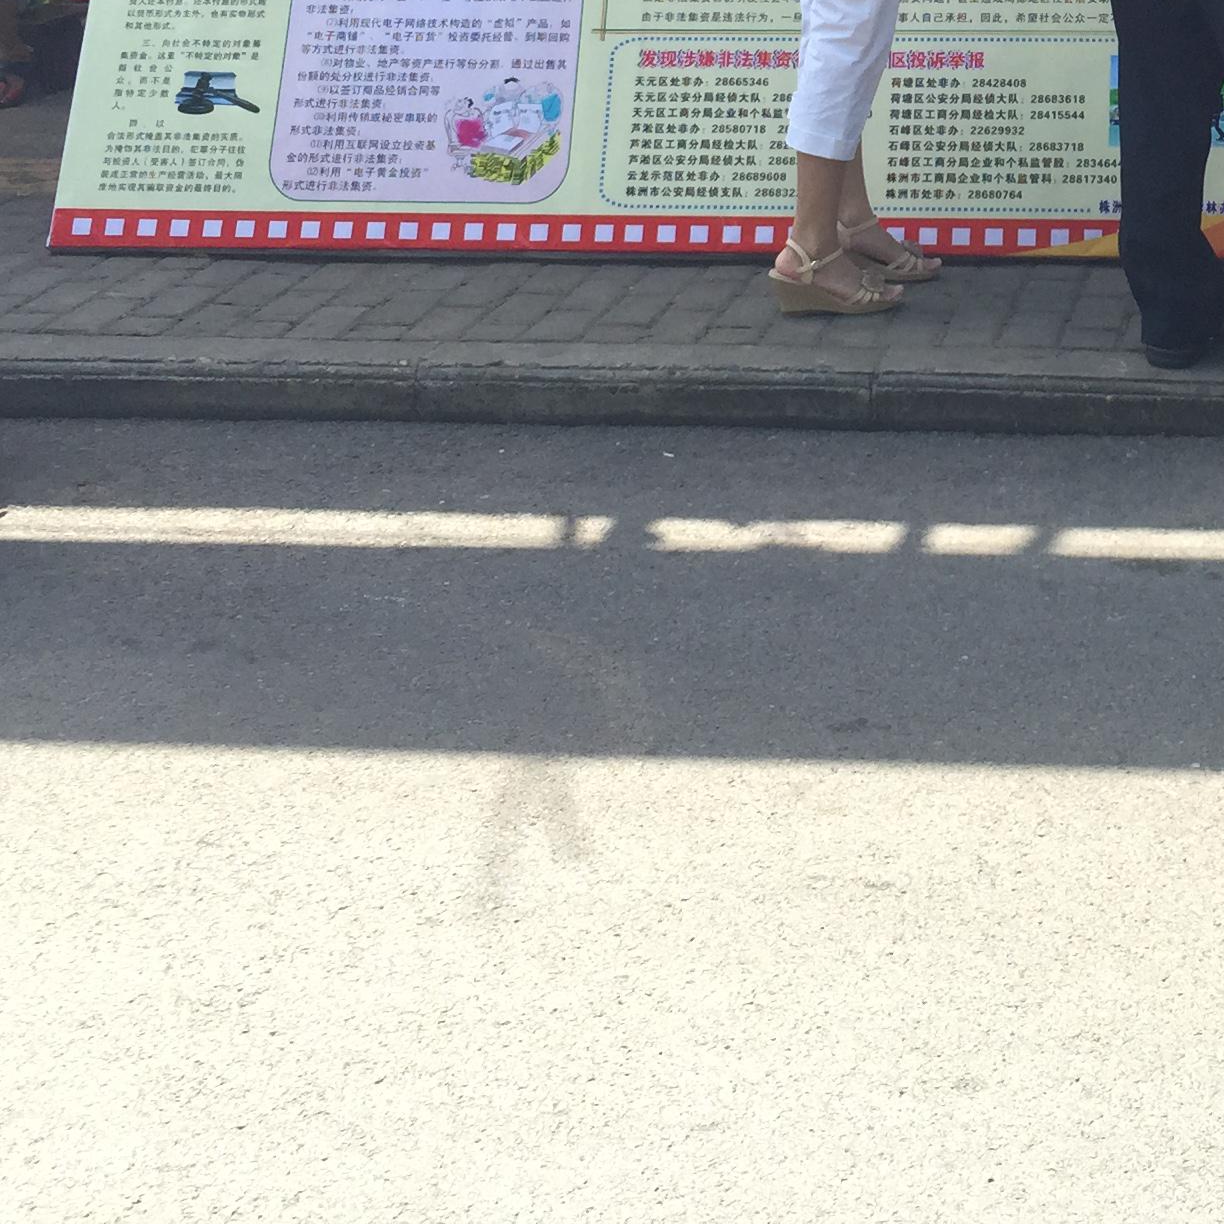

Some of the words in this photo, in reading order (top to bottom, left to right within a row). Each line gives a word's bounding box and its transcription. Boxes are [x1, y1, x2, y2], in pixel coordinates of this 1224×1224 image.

[639, 49, 799, 69] 发现涉嫌非法集资
[888, 51, 985, 69] 区投诉举报
[631, 107, 789, 119] 天元区工商分局企业和个私监
[627, 154, 799, 167] 芦淞区公安分局经侦大队：2868
[625, 186, 799, 199] 株洲市公安局经侦支队：286832
